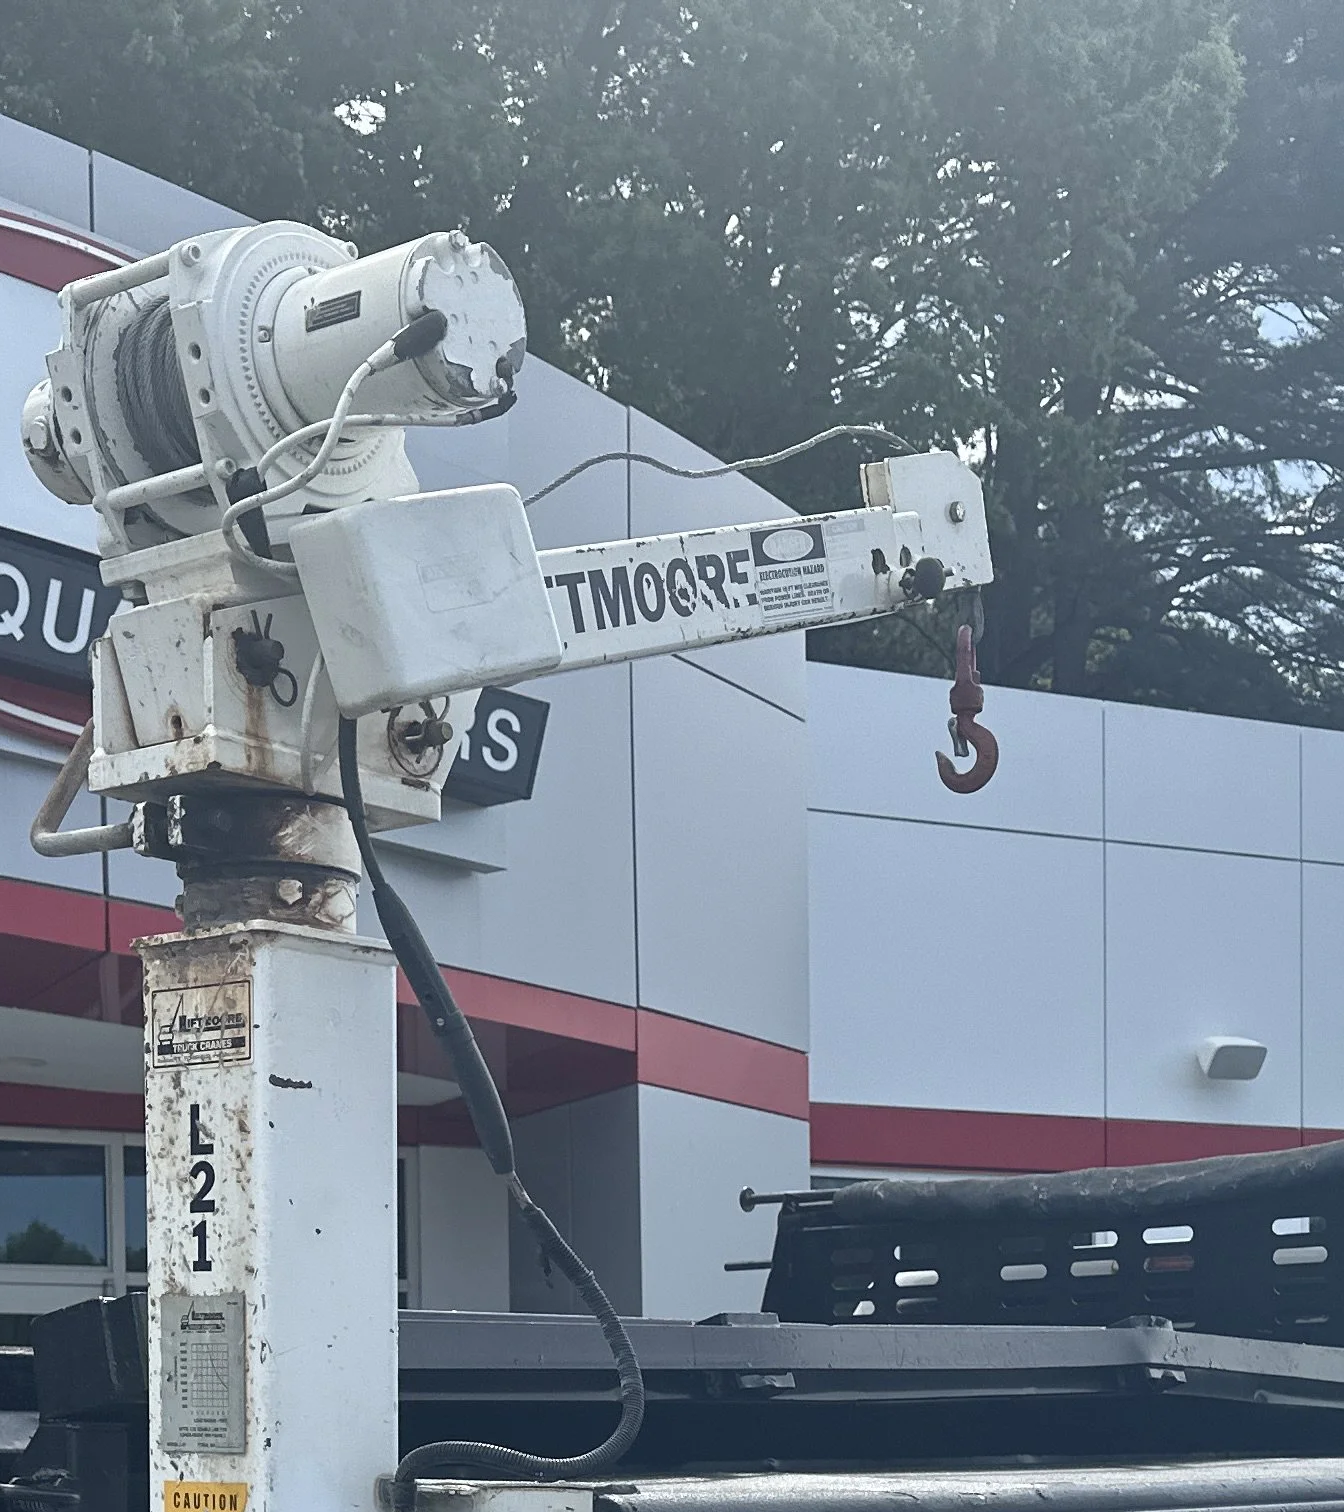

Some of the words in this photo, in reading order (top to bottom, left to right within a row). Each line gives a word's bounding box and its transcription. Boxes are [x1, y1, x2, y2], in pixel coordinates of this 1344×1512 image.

[802, 563, 825, 575] HAZARD
[544, 549, 759, 634] TMOORE
[172, 1042, 198, 1054] TRUCK
[199, 1038, 232, 1051] CRANES
[172, 1490, 239, 1512] CAUTION
